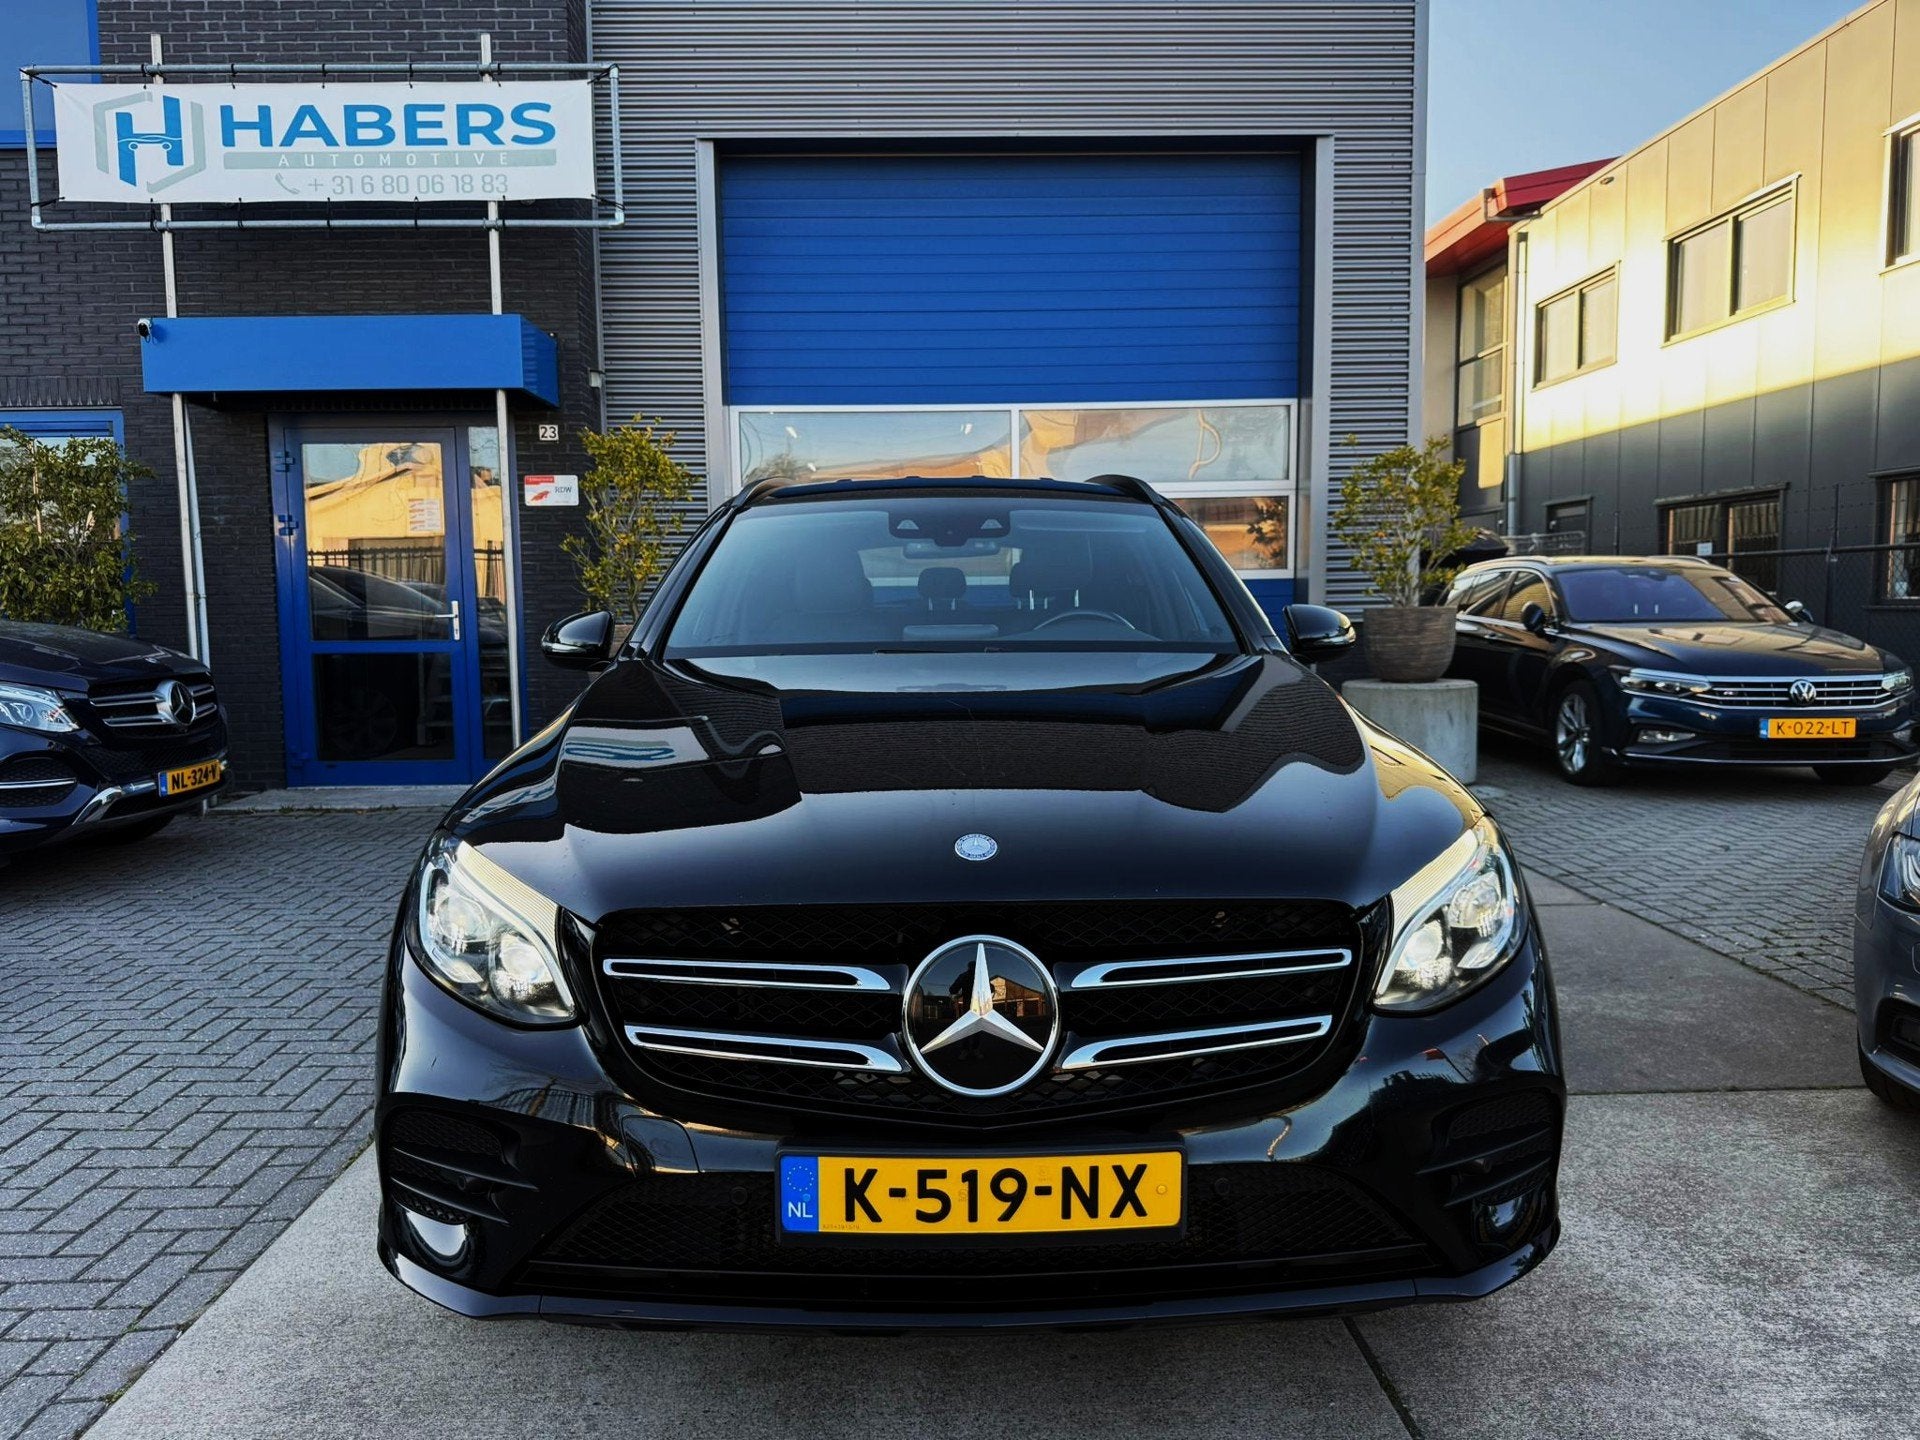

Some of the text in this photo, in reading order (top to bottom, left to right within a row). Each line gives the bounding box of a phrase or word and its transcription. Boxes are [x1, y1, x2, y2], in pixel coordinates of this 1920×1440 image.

[220, 102, 556, 147] HABERS
[278, 152, 508, 167] AUTOMOTIVE
[360, 175, 375, 195] 6
[382, 175, 410, 195] 80
[417, 175, 445, 195] 06
[451, 174, 474, 194] 18
[481, 174, 508, 193] 83
[540, 426, 557, 439] 23
[1776, 721, 1850, 735] K-022-LT
[171, 763, 218, 791] NL-324-V
[844, 1163, 1148, 1224] K-519-NX
[788, 1201, 813, 1218] NL
